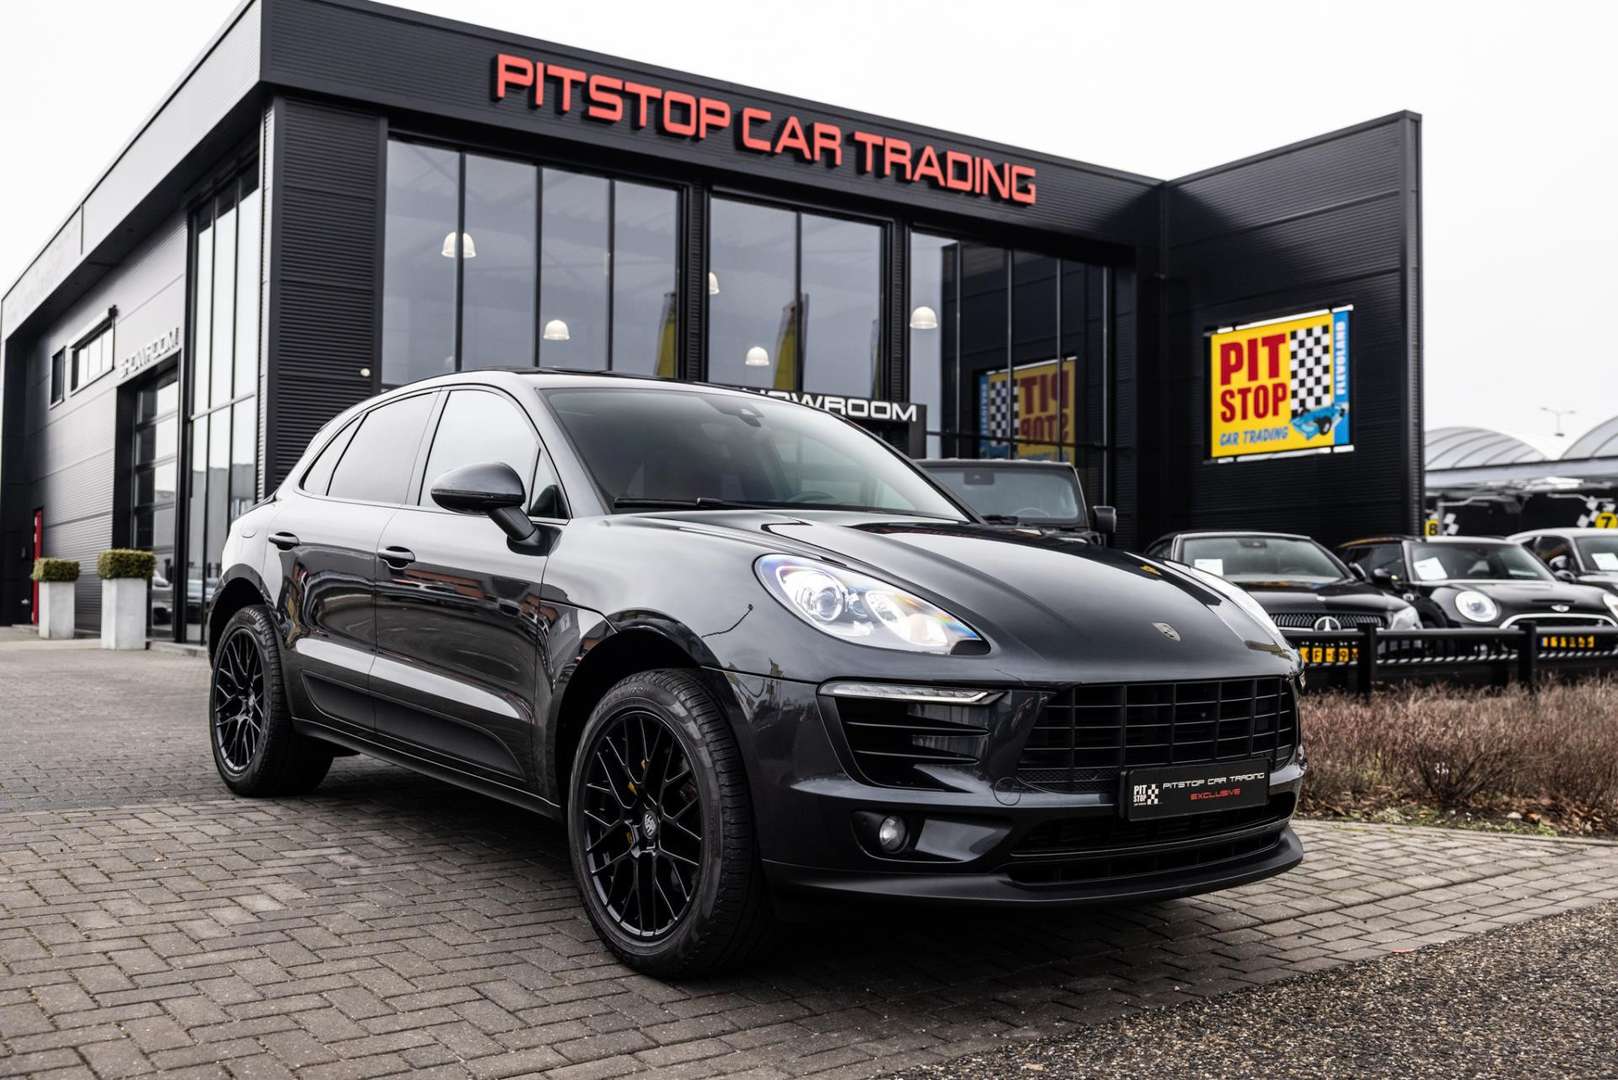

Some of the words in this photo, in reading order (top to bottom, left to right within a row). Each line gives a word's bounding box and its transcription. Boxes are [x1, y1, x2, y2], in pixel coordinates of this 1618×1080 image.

[497, 54, 731, 139] PITSTOP
[742, 107, 842, 167] CAR
[854, 131, 1037, 205] TRADING
[1219, 333, 1287, 386] PIT
[1219, 382, 1288, 424] STOP
[1219, 431, 1240, 447] CAR
[1242, 426, 1289, 445] TRADING
[1601, 516, 1612, 529] 7
[1133, 784, 1148, 796] PIT
[1162, 780, 1205, 790] PITSTOP
[1207, 776, 1227, 785] CAR
[1132, 793, 1147, 803] STOP
